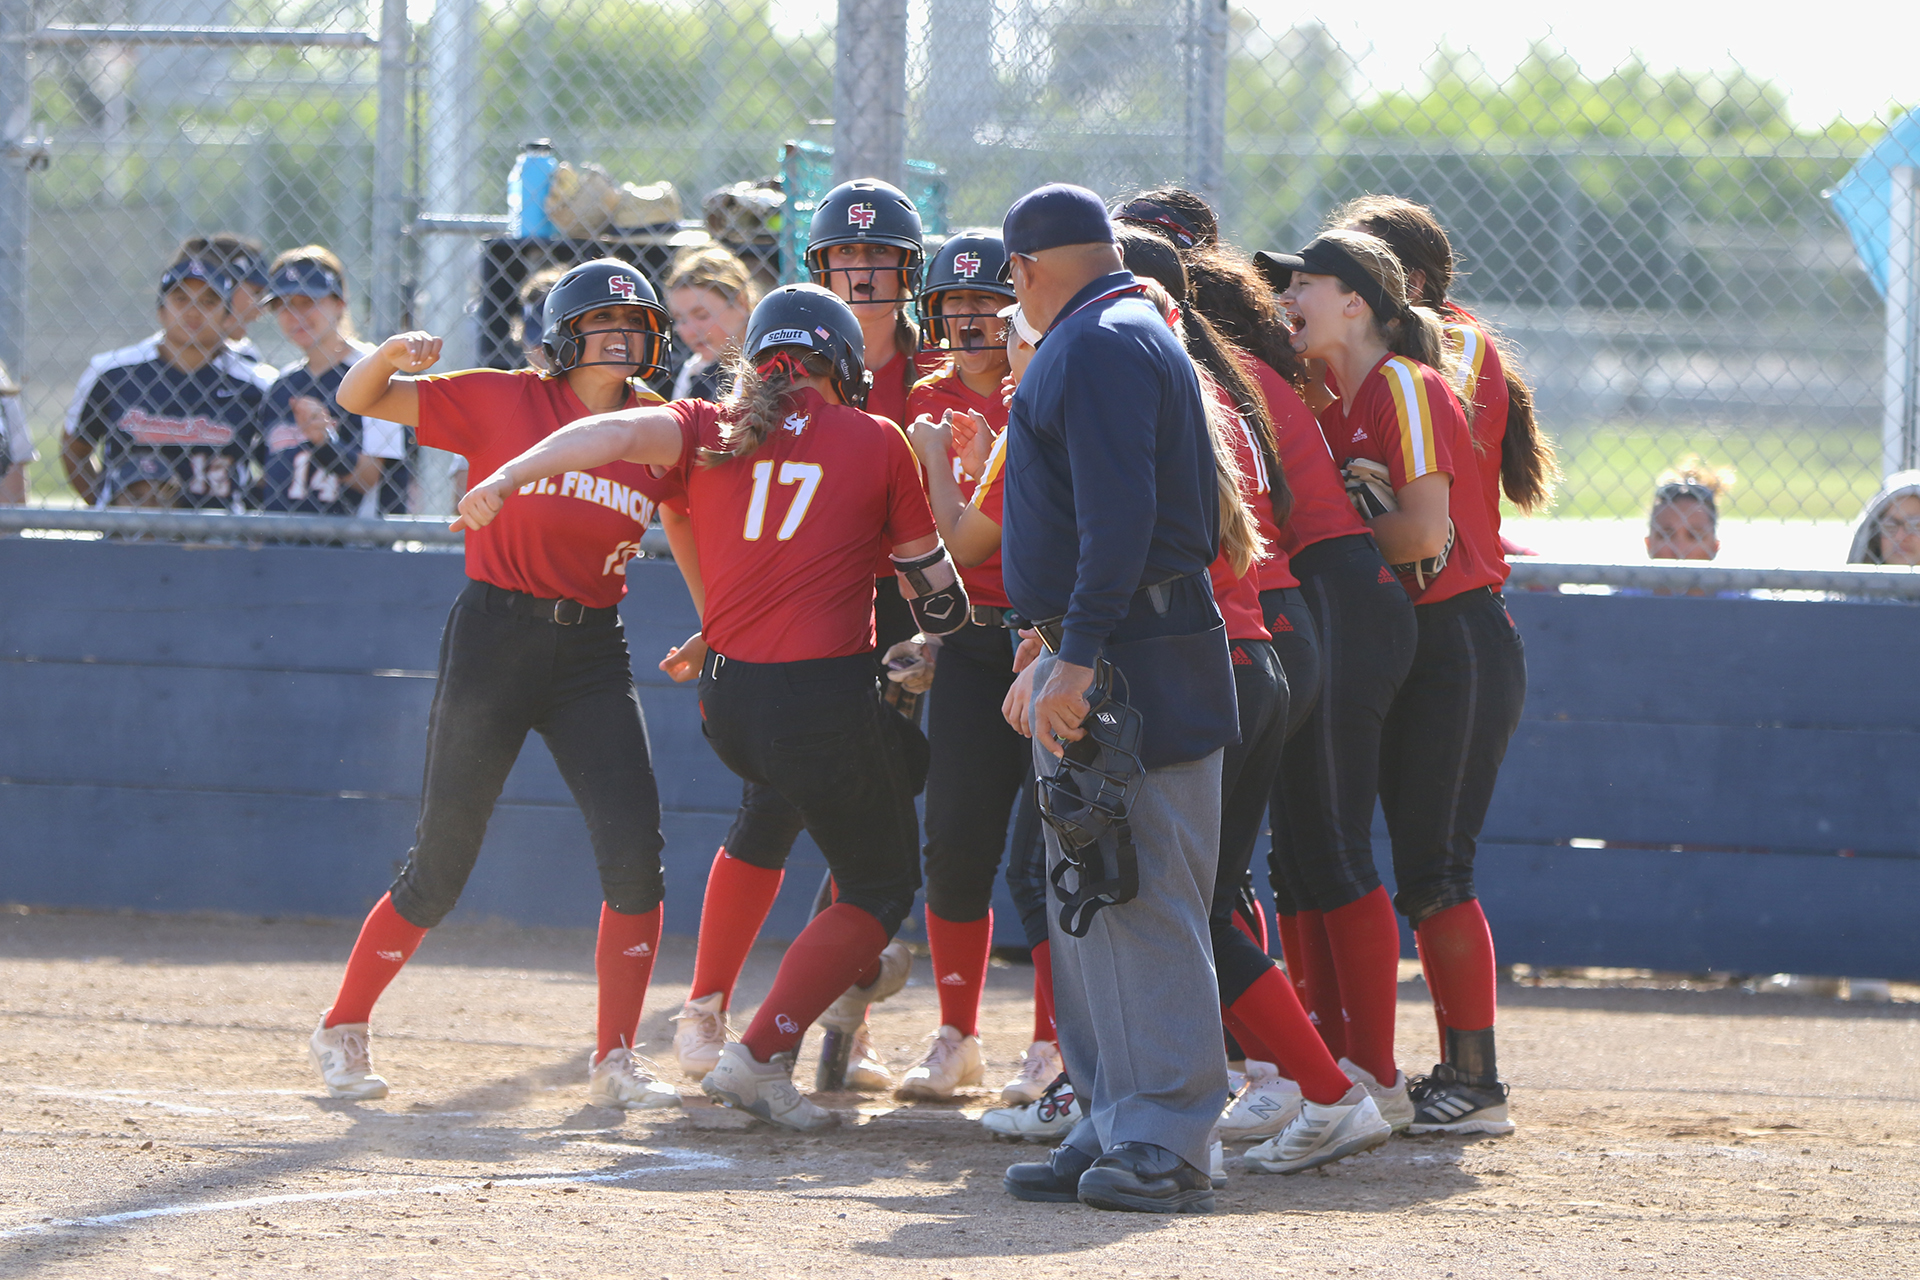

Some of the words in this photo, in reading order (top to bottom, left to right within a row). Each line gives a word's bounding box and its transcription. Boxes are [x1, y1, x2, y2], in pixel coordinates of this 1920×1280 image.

[848, 203, 876, 229] SF
[954, 252, 981, 278] SF
[608, 275, 636, 299] SF
[768, 329, 804, 340] schutt
[287, 451, 340, 502] 14
[743, 459, 824, 541] 17
